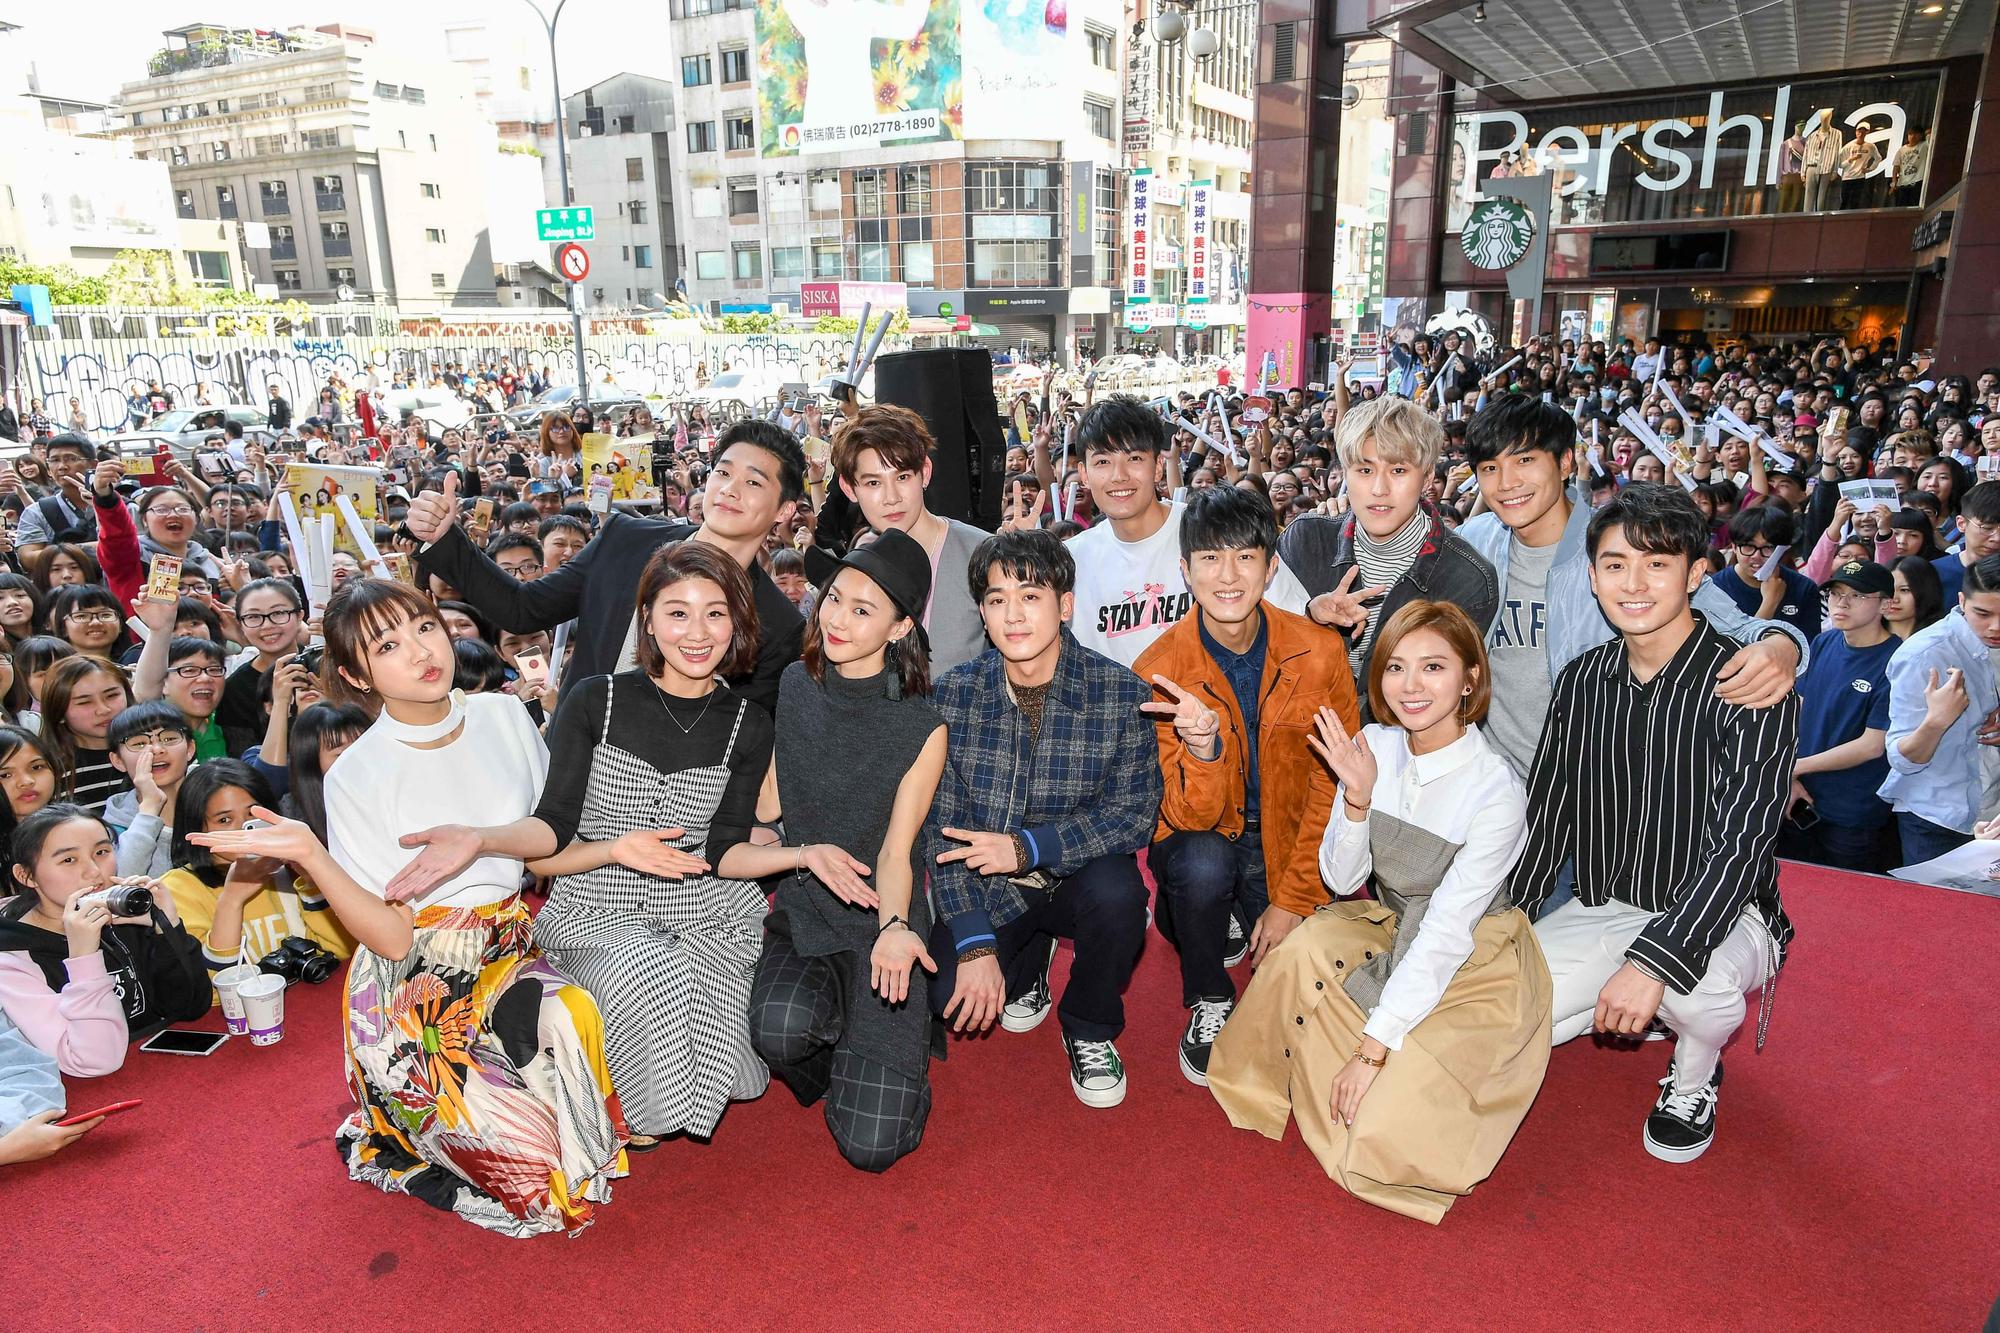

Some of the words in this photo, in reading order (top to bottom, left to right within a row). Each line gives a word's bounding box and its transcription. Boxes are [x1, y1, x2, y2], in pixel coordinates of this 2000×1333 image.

[1142, 45, 1151, 115] MOTEL
[803, 126, 846, 143] 佛瑞廣告
[850, 117, 935, 138] (02)2778-1890
[1133, 179, 1147, 294] 地球村美日韓語
[1193, 190, 1206, 295] 地球村美日韓語
[803, 290, 838, 304] SISKA
[1097, 600, 1147, 632] STAY
[1151, 592, 1197, 624] REA
